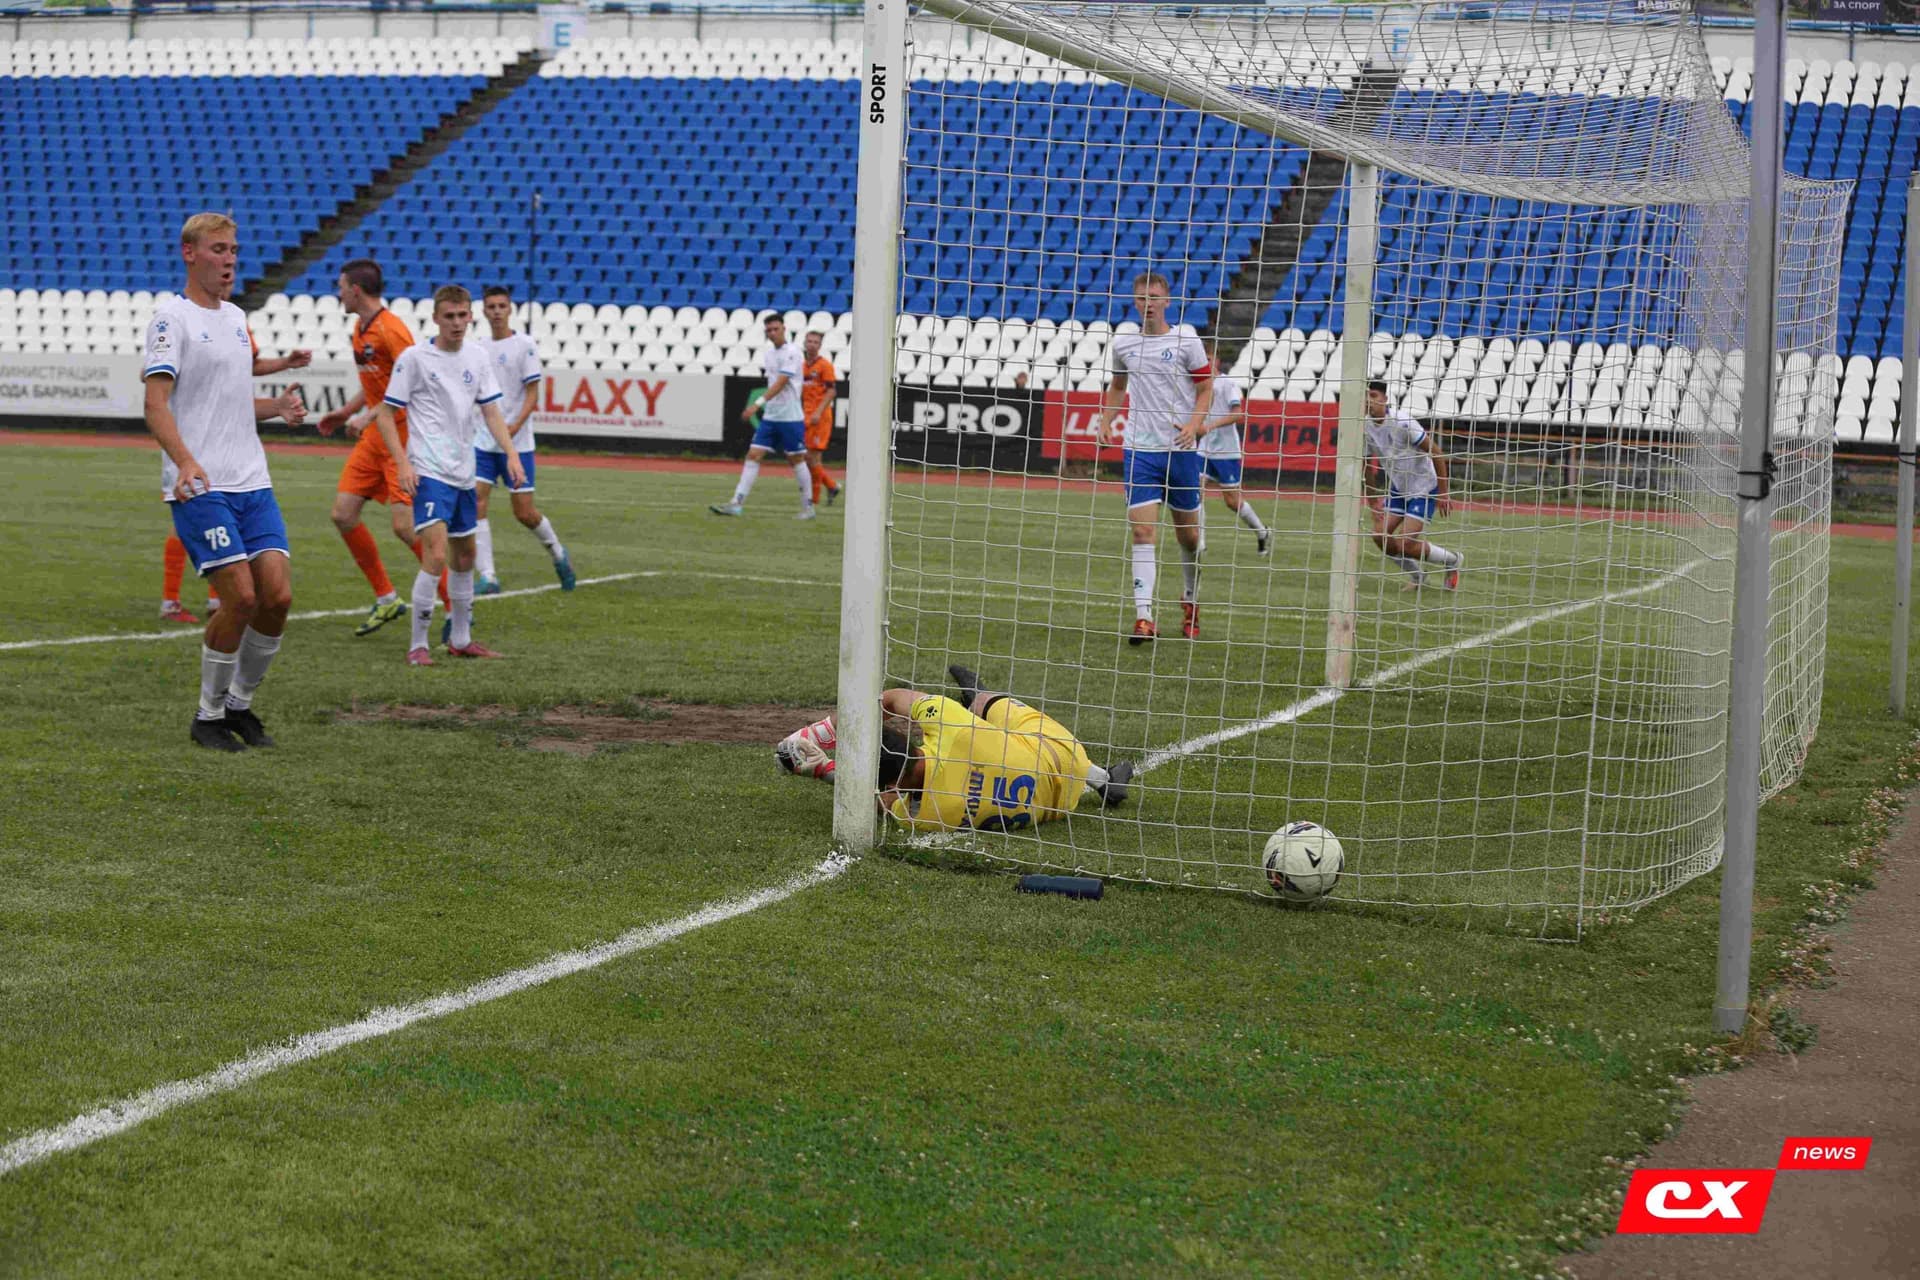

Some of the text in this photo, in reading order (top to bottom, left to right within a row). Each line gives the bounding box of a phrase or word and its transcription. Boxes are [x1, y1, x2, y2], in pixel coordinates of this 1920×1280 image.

[1833, 1, 1880, 10] ЗА СПОРТ
[870, 63, 887, 124] SPORT
[533, 376, 667, 416] LAXY
[425, 502, 435, 518] 7
[204, 526, 231, 551] 78
